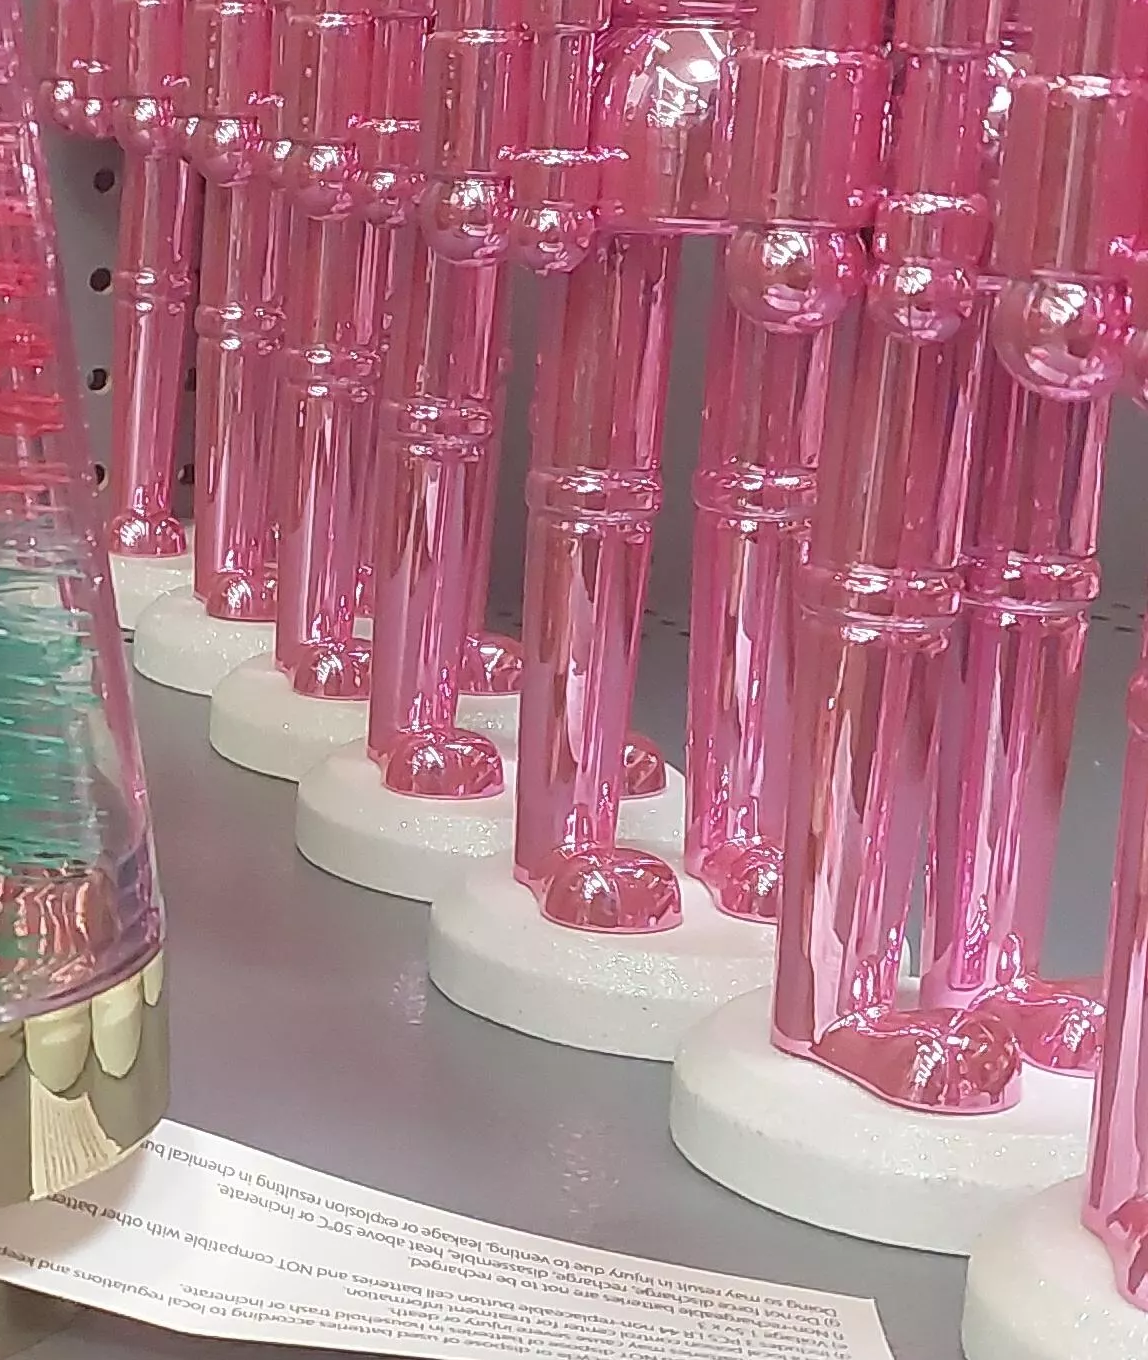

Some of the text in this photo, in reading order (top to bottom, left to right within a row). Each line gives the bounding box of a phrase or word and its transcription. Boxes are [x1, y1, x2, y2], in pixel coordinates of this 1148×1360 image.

[168, 1146, 235, 1177] chemical
[240, 1171, 252, 1186] in
[256, 1174, 321, 1205] resulting
[217, 1183, 295, 1219] incinerate.
[101, 1208, 143, 1229] other
[298, 1211, 314, 1222] or
[325, 1199, 398, 1228] explosion
[146, 1221, 180, 1240] with
[317, 1216, 352, 1236] 50°C
[402, 1223, 418, 1235] or
[357, 1227, 405, 1248] above
[421, 1227, 481, 1252] leakage
[184, 1233, 274, 1264] compatible
[408, 1239, 443, 1259] heat
[39, 1260, 70, 1274] and
[277, 1259, 312, 1276] NOT
[408, 1257, 491, 1281] recharged.
[447, 1249, 548, 1279] disassemble,
[553, 1260, 569, 1269] to
[573, 1263, 604, 1276] due
[317, 1268, 347, 1281] and
[496, 1276, 516, 1287] be
[552, 1271, 627, 1293] recharge,
[609, 1268, 653, 1286] injury
[73, 1270, 163, 1300] regulations
[352, 1275, 422, 1296] batteries
[521, 1280, 537, 1290] to
[542, 1283, 569, 1294] not
[658, 1279, 672, 1289] in
[677, 1282, 721, 1296] result
[180, 1284, 263, 1307] incinerate.
[343, 1286, 443, 1311] information.
[427, 1290, 454, 1300] cell
[458, 1295, 514, 1311] button
[574, 1290, 599, 1299] are
[631, 1286, 714, 1309] discharge,
[725, 1290, 760, 1303] may
[764, 1298, 782, 1307] so
[168, 1296, 204, 1314] local
[210, 1306, 226, 1316] to
[268, 1301, 284, 1310] or
[290, 1304, 330, 1317] trash
[603, 1294, 674, 1314] batteries
[719, 1302, 759, 1316] force
[787, 1300, 836, 1317] Doing
[232, 1308, 315, 1326] according
[335, 1311, 423, 1331] household
[448, 1304, 530, 1324] treatment
[518, 1305, 654, 1332] non-replaceable
[765, 1310, 790, 1320] not
[796, 1315, 819, 1326] Do
[320, 1321, 392, 1337] batteries
[465, 1318, 512, 1332] injury
[536, 1319, 558, 1329] for
[679, 1307, 829, 1339] Non-rechargeable
[398, 1331, 438, 1341] used
[464, 1341, 531, 1353] dispose
